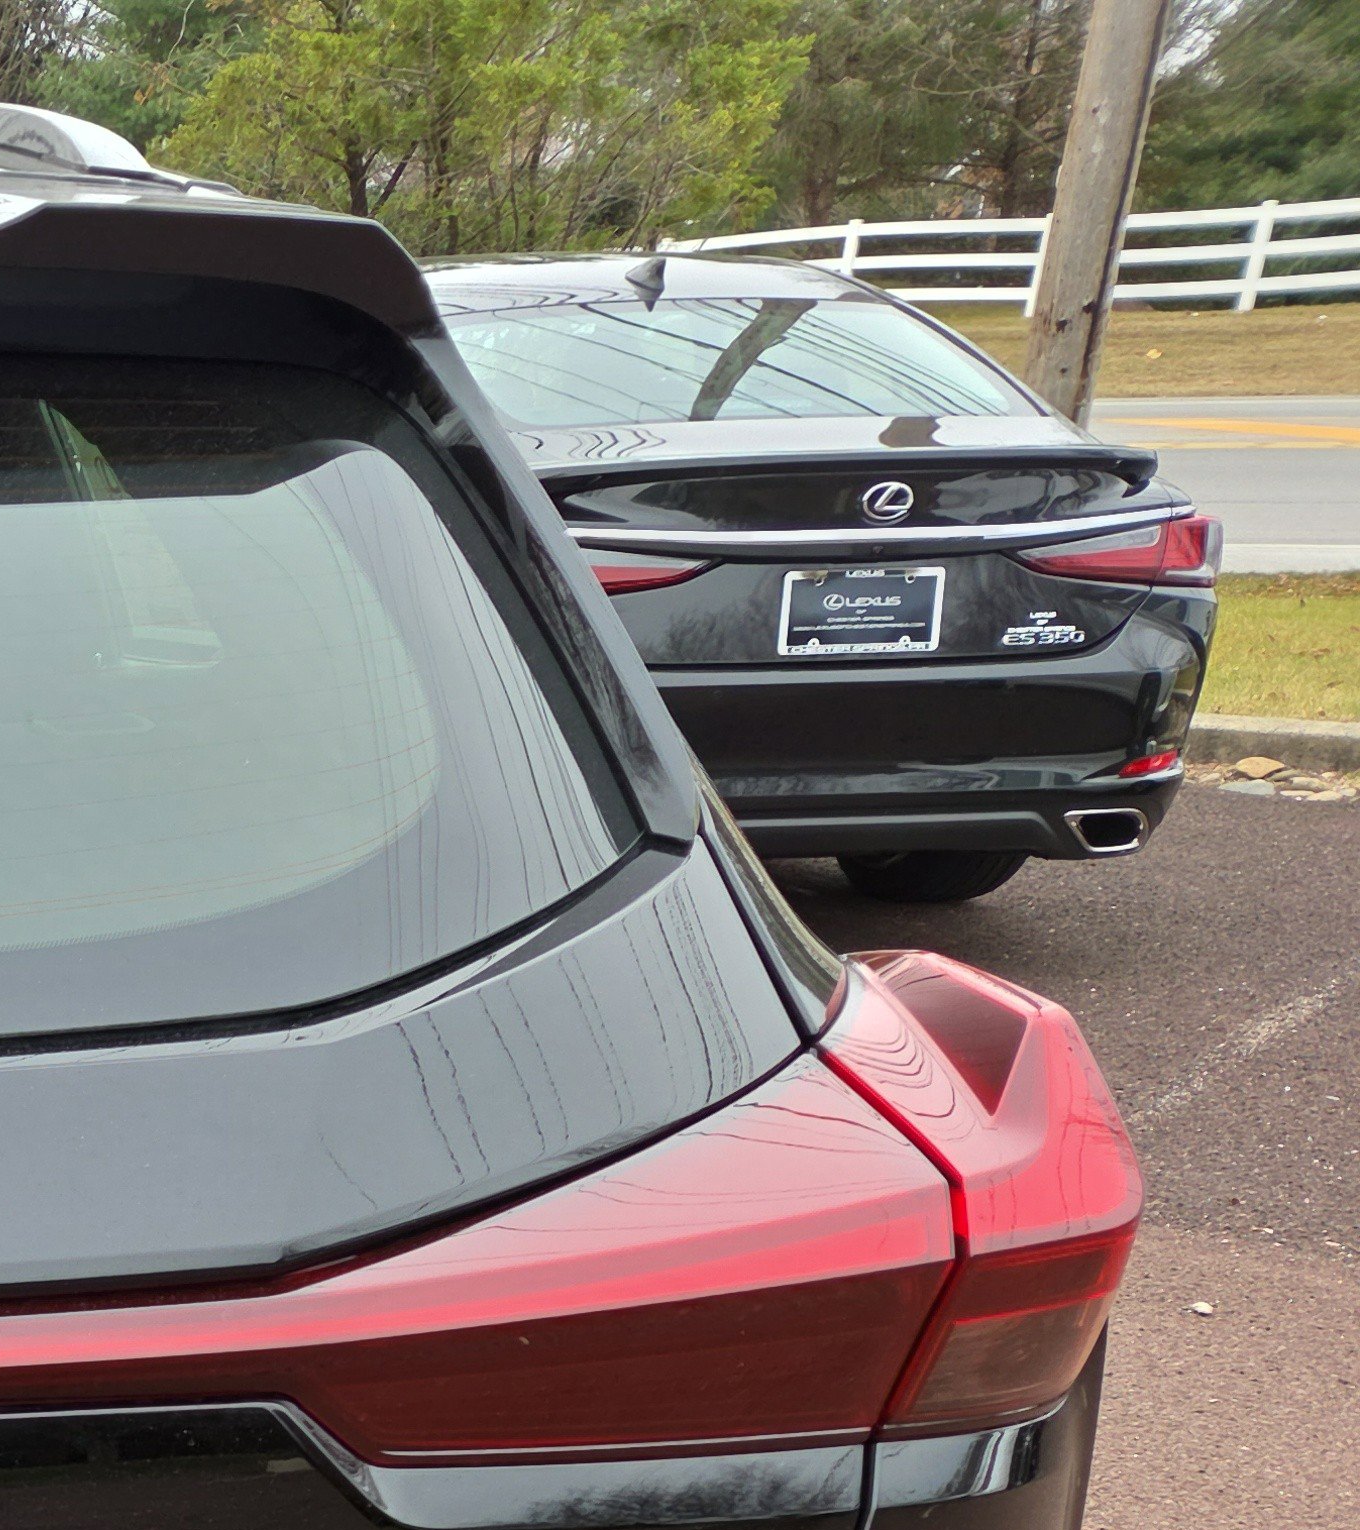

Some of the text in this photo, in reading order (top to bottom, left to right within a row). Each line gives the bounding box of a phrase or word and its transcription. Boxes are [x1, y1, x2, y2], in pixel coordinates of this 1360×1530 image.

[845, 596, 902, 607] LEXUS
[1002, 630, 1086, 646] ES 350
